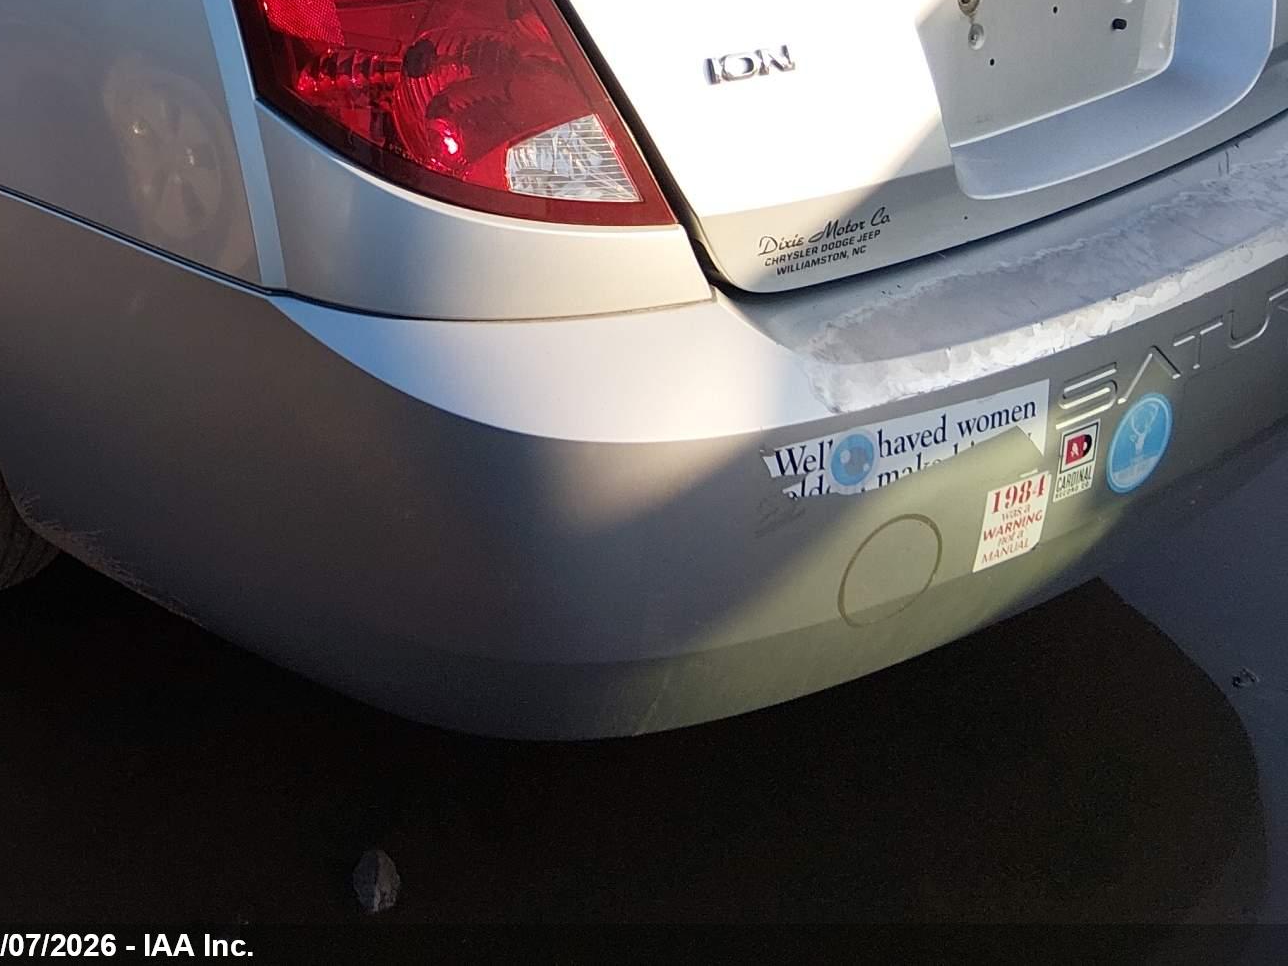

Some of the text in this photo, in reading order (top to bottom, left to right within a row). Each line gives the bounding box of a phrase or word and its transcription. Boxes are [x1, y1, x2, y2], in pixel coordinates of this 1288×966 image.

[703, 44, 796, 86] ION
[758, 234, 805, 256] Dixie
[808, 220, 866, 243] Motor
[765, 229, 881, 267] CHRYSLER DODGE JEEP
[776, 245, 868, 276] WILLIAMSTON, NC
[957, 400, 1036, 438] women
[992, 474, 1046, 514] 1984
[1056, 465, 1092, 490] CARDINAL
[983, 510, 1043, 541] WARNING
[982, 538, 1030, 563] MANUAL
